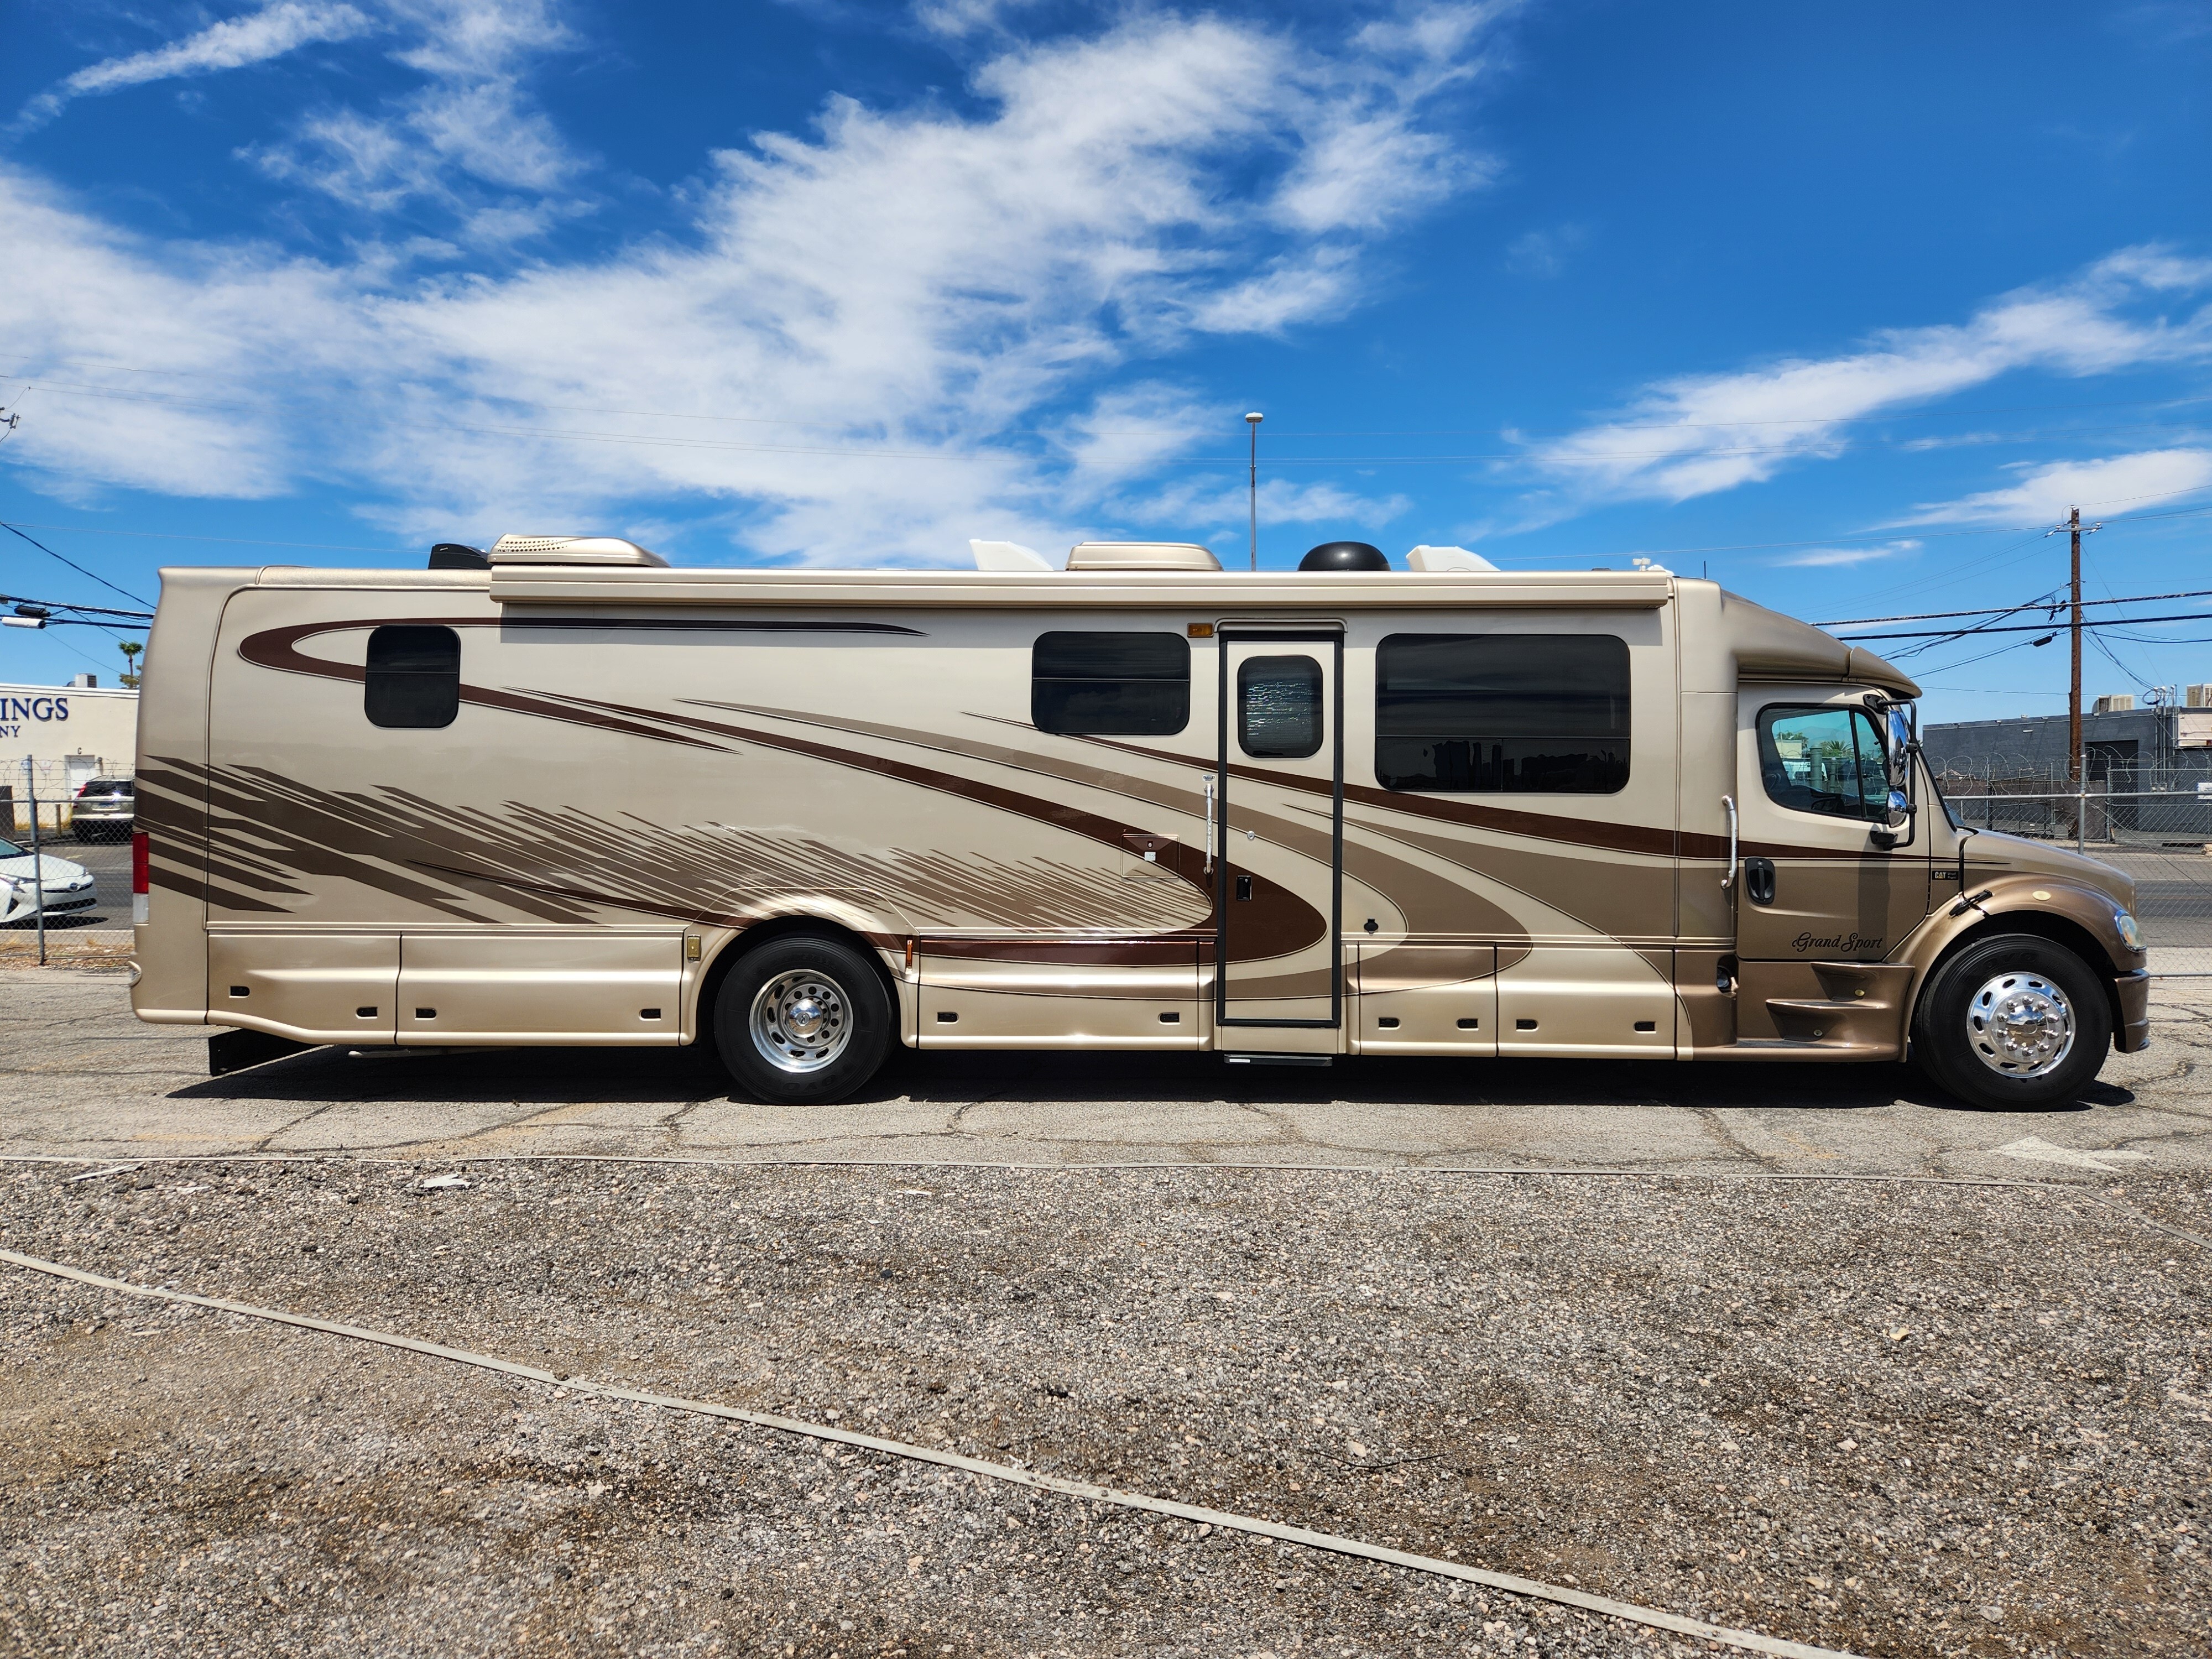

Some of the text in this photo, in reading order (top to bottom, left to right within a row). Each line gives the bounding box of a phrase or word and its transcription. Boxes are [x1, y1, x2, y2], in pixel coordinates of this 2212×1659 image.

[1, 697, 69, 721] INGS
[0, 726, 21, 738] NY
[1792, 932, 1883, 952] Grand Sport
